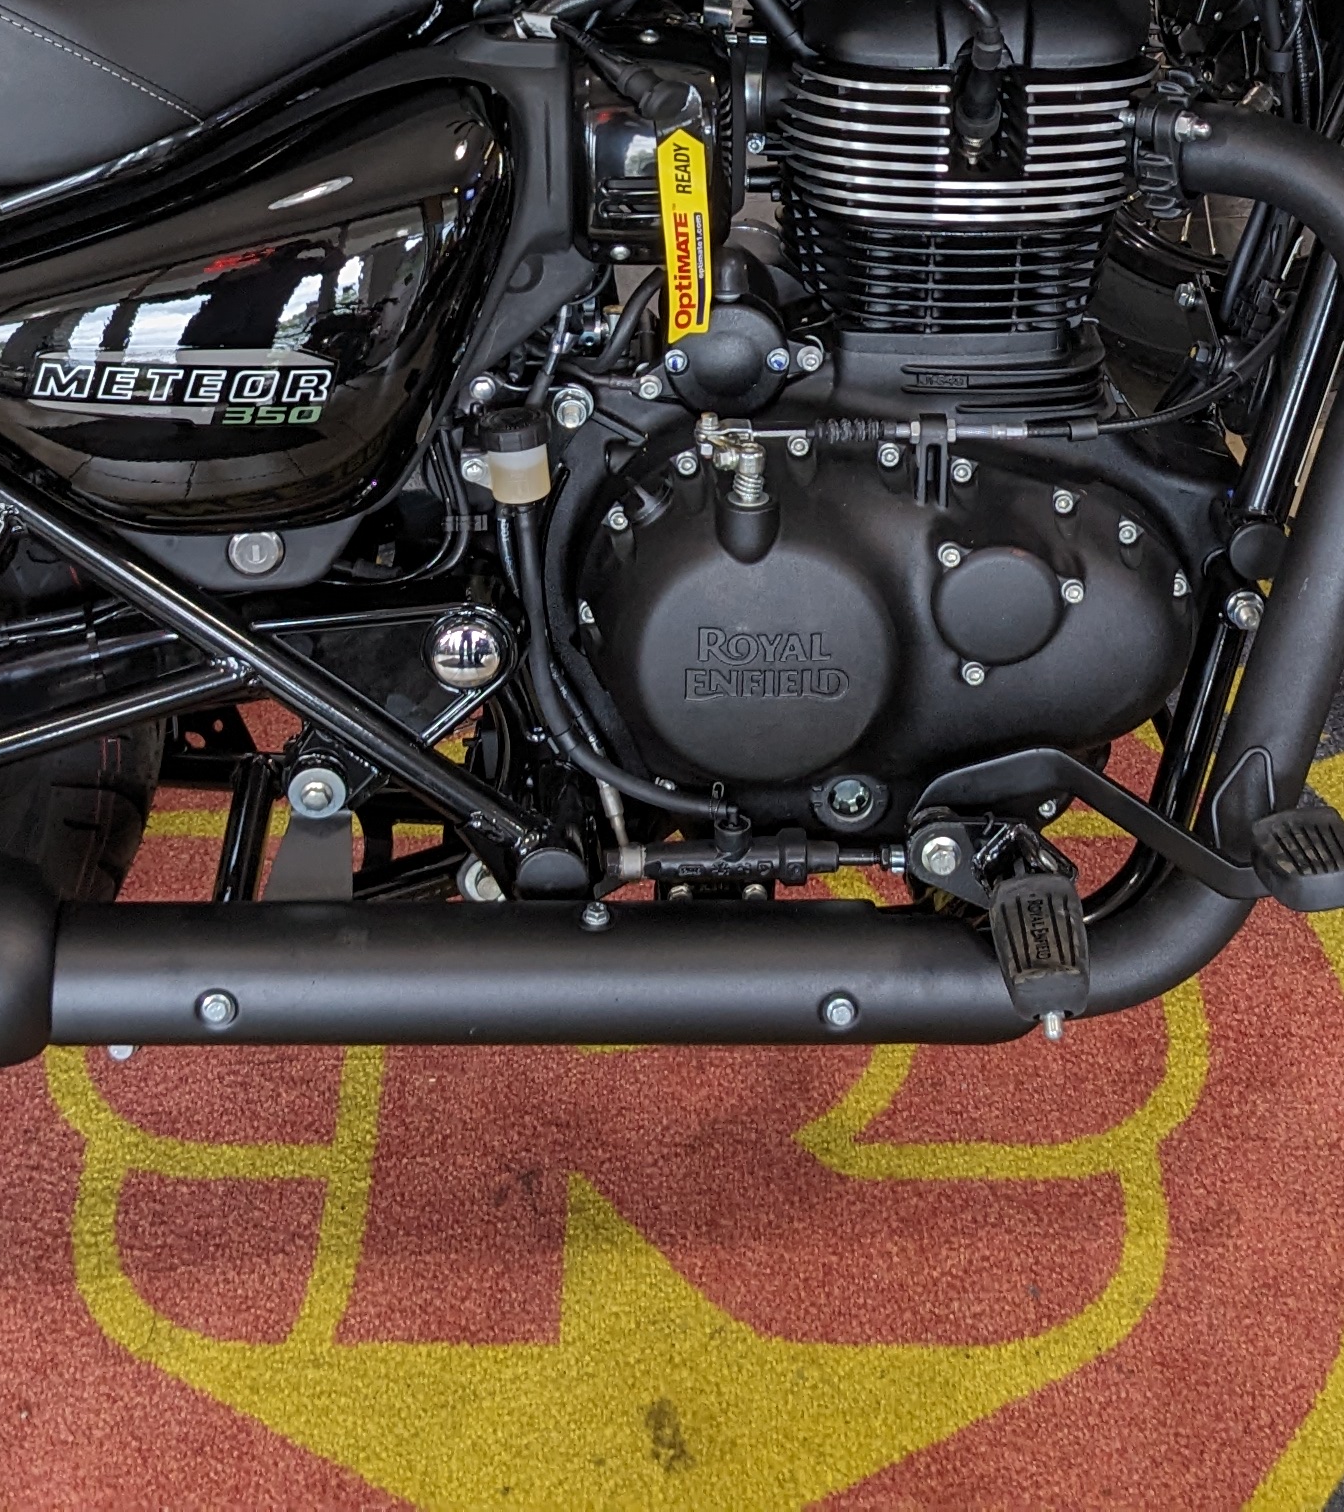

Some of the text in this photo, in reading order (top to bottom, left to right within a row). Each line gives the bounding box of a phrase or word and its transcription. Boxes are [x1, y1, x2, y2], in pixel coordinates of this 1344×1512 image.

[672, 142, 693, 195] READY
[32, 362, 333, 403] METEOR
[222, 405, 323, 426] 350
[697, 626, 832, 666] ROYAL
[684, 667, 850, 702] ENFIELD
[1027, 898, 1045, 927] ROYAL
